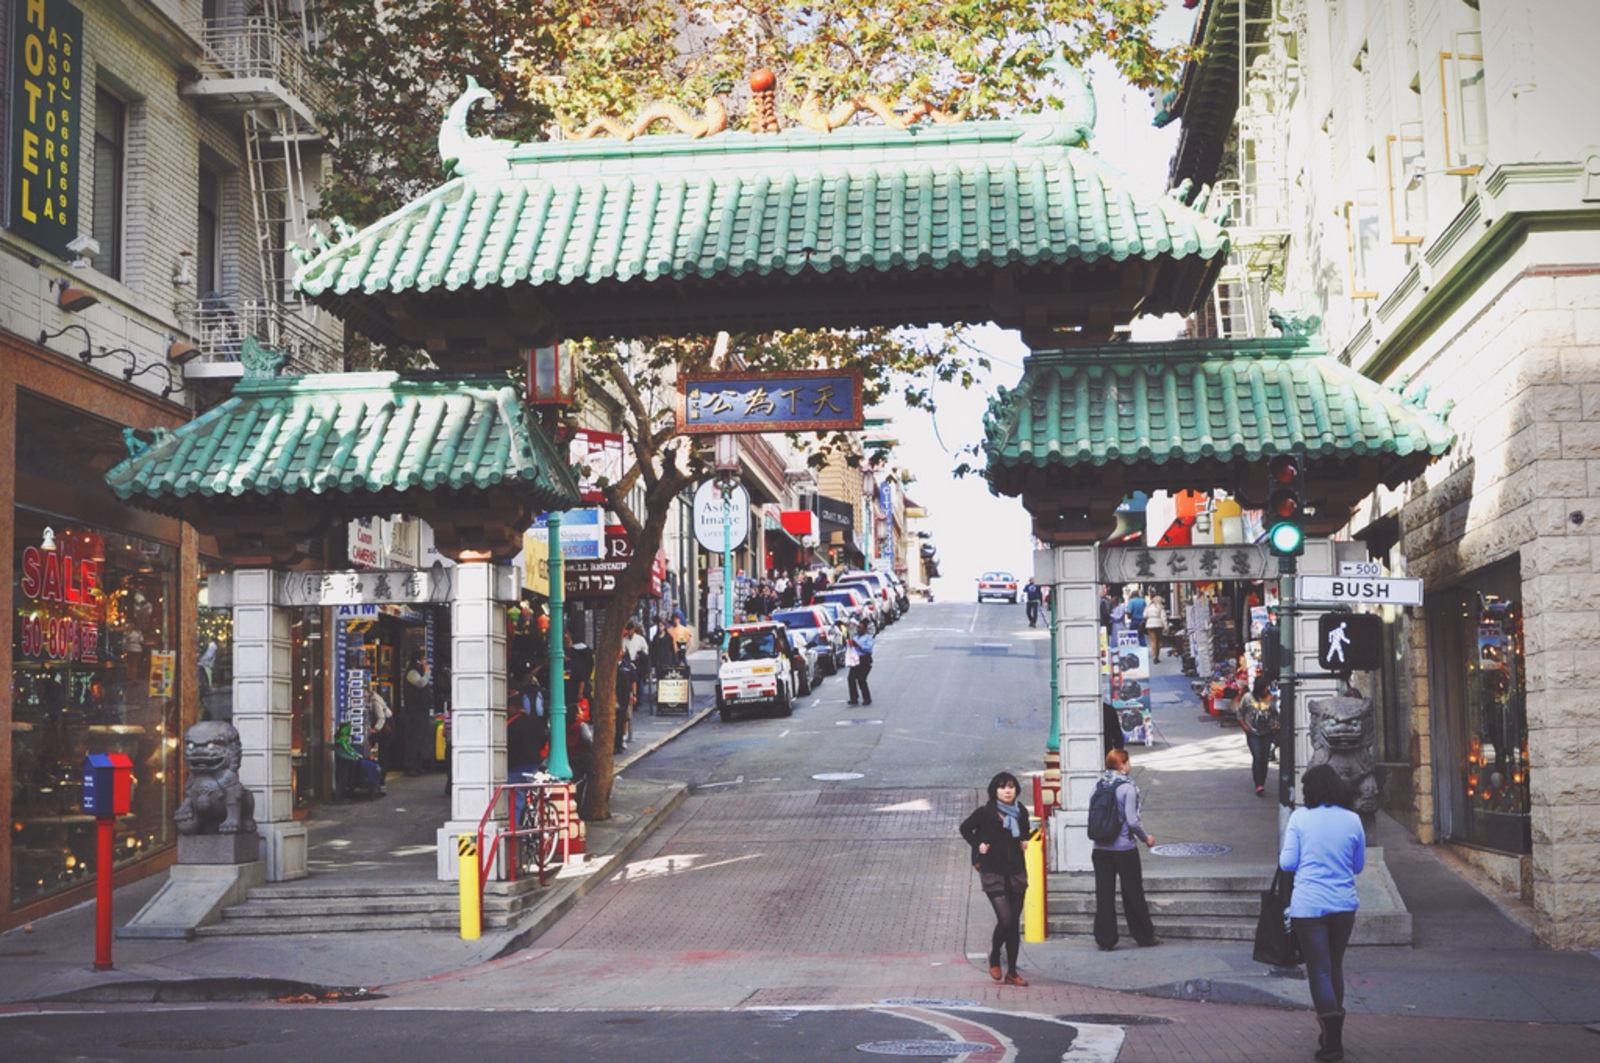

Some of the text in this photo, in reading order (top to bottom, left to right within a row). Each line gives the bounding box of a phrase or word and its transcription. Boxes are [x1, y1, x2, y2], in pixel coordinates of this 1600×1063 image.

[22, 0, 45, 224] HOTEL
[43, 27, 58, 220] ASTORIA
[704, 502, 739, 512] Asin
[1356, 563, 1379, 575] 500
[21, 545, 98, 608] SALE
[1332, 582, 1390, 598] BUSH
[340, 604, 376, 615] ATM
[1119, 639, 1137, 647] ATM
